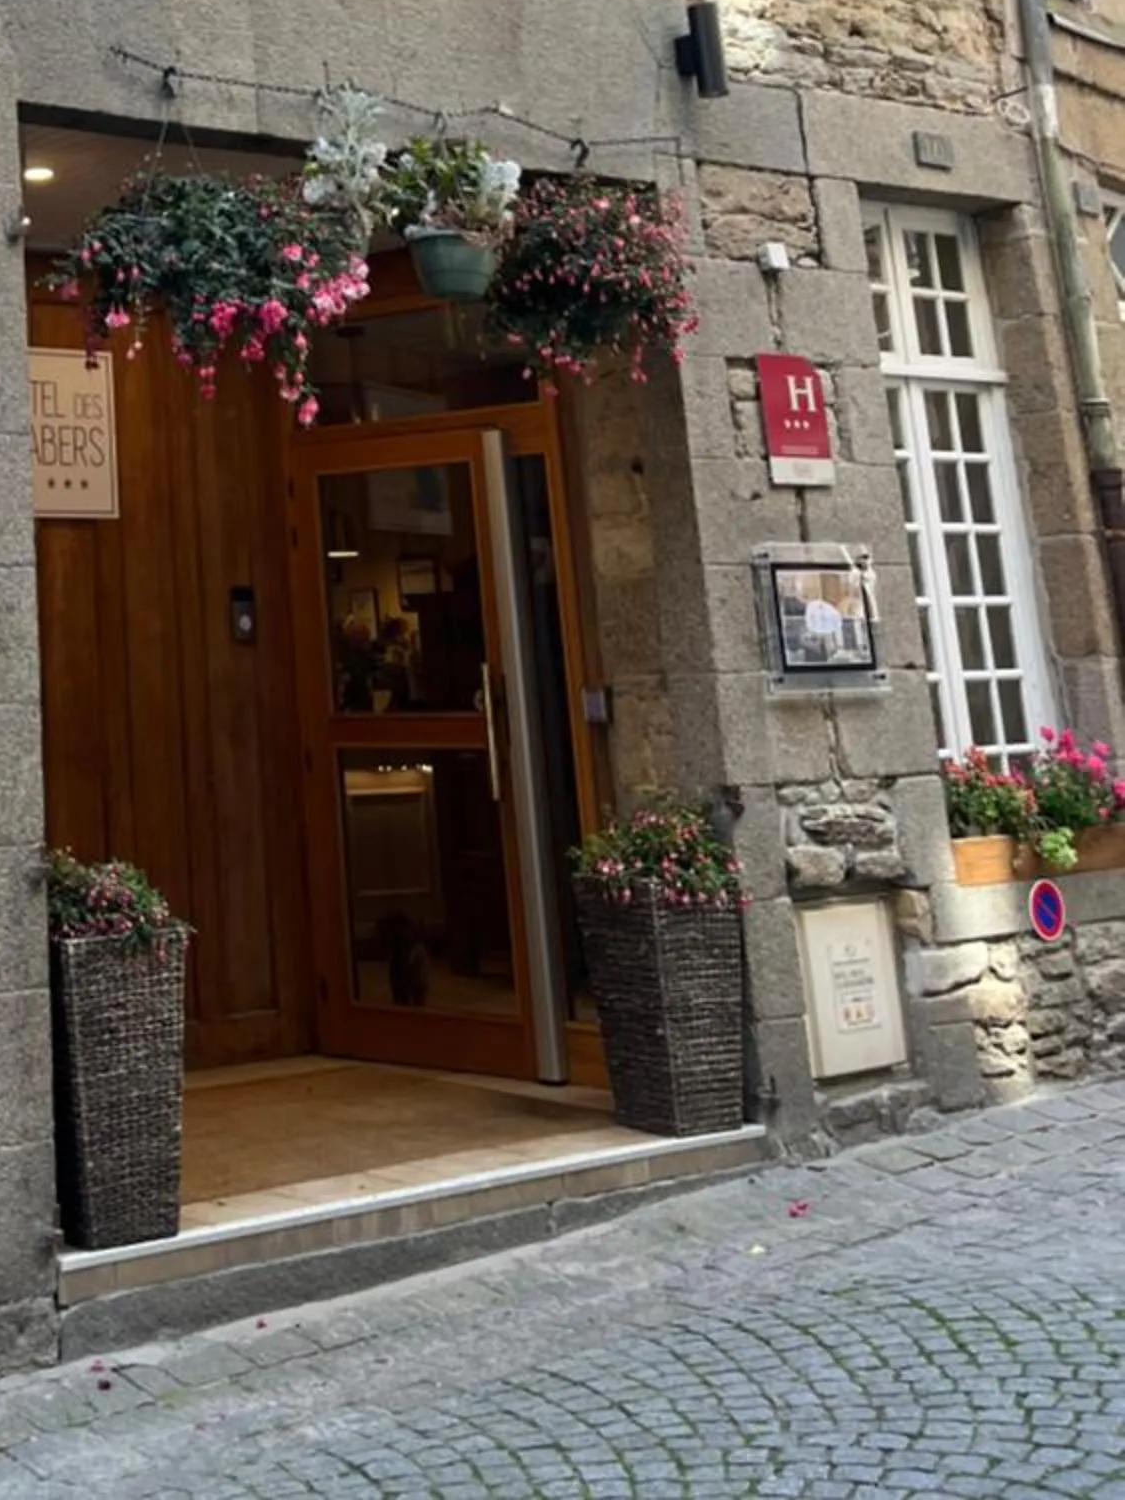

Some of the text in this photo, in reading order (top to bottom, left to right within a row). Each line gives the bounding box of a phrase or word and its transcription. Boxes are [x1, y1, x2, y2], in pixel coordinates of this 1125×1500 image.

[30, 381, 105, 421] TEL DES
[786, 374, 817, 412] H
